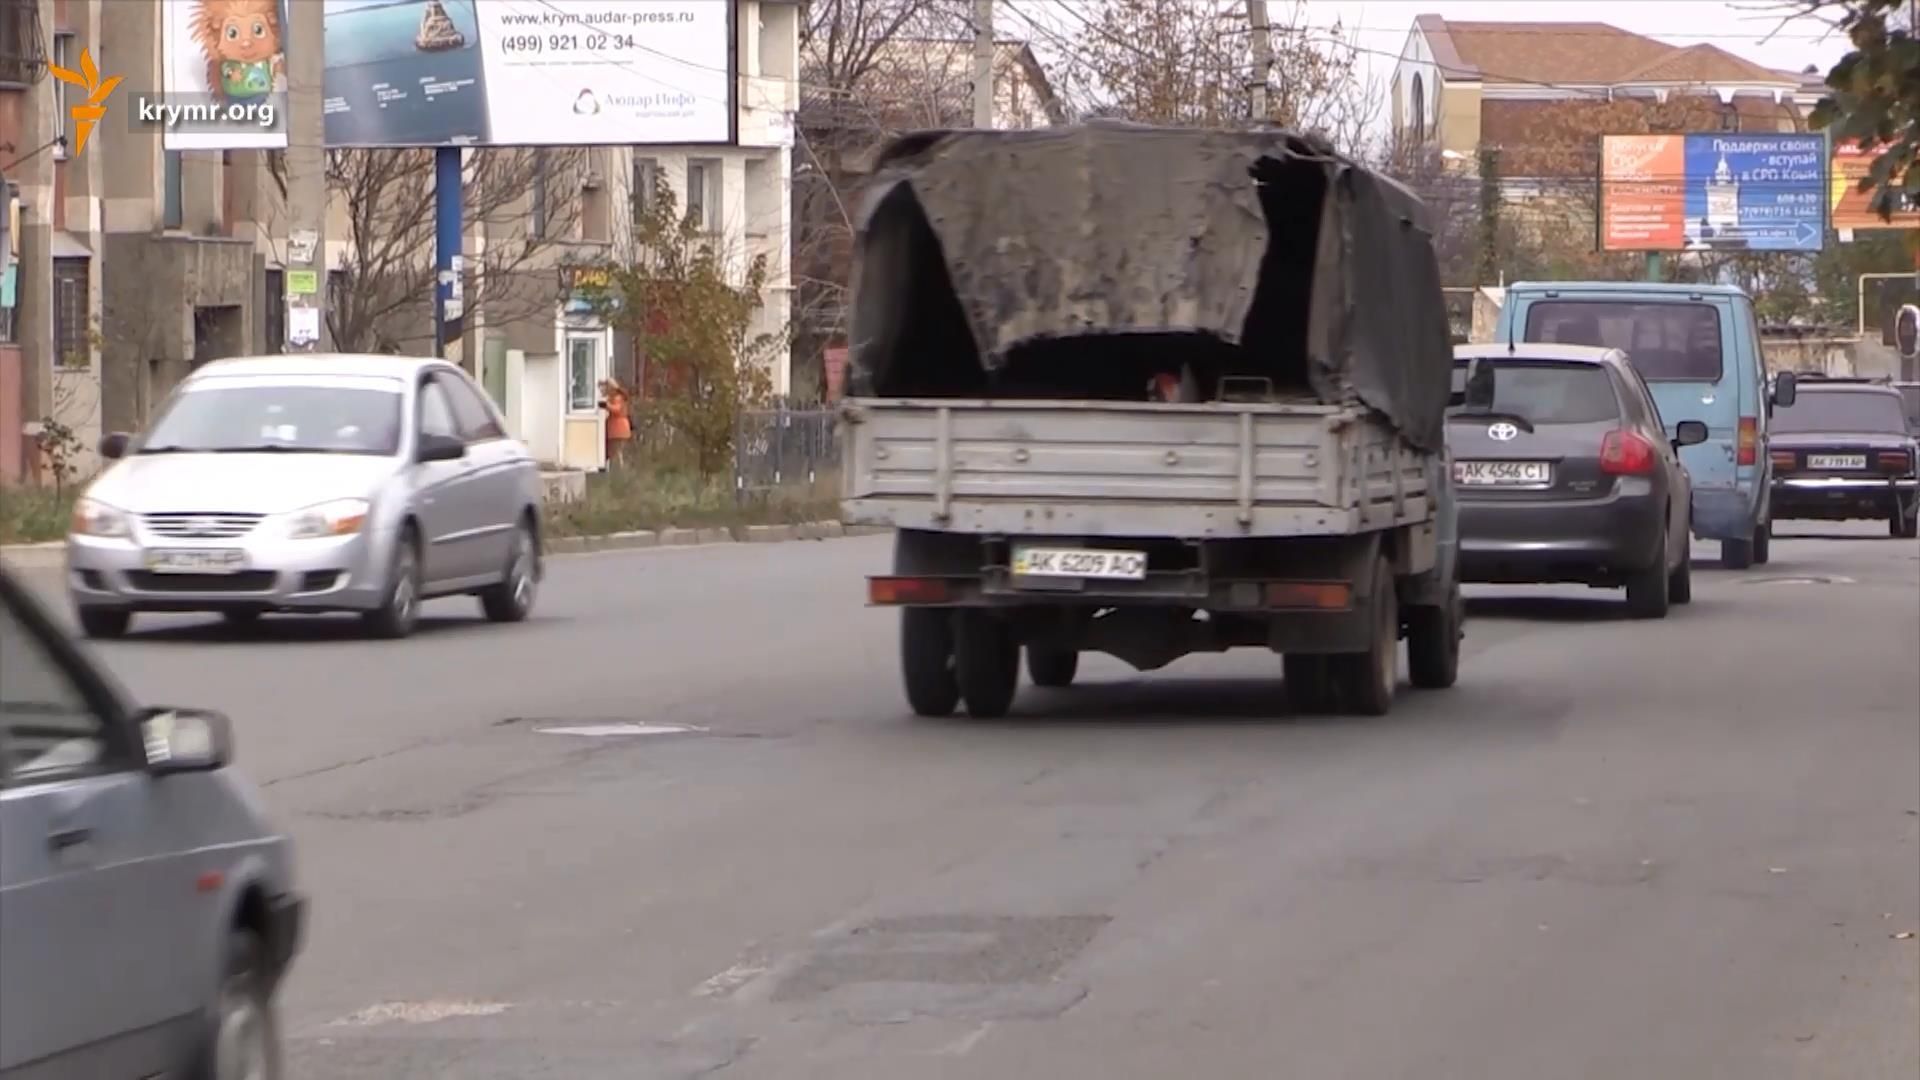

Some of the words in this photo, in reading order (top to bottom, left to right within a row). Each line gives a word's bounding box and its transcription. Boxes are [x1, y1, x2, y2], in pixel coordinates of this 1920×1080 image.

[501, 11, 694, 26] www.krym.audar-press.ru
[502, 35, 542, 54] (499)
[549, 35, 577, 50] 921
[586, 35, 607, 50] 02
[614, 34, 634, 49] 34
[1713, 139, 1777, 154] Поддержи
[1780, 141, 1817, 152] своих
[1769, 153, 1817, 168] вступай
[1752, 168, 1778, 181] СРО
[1030, 552, 1056, 570] AK
[1060, 554, 1105, 572] 6209
